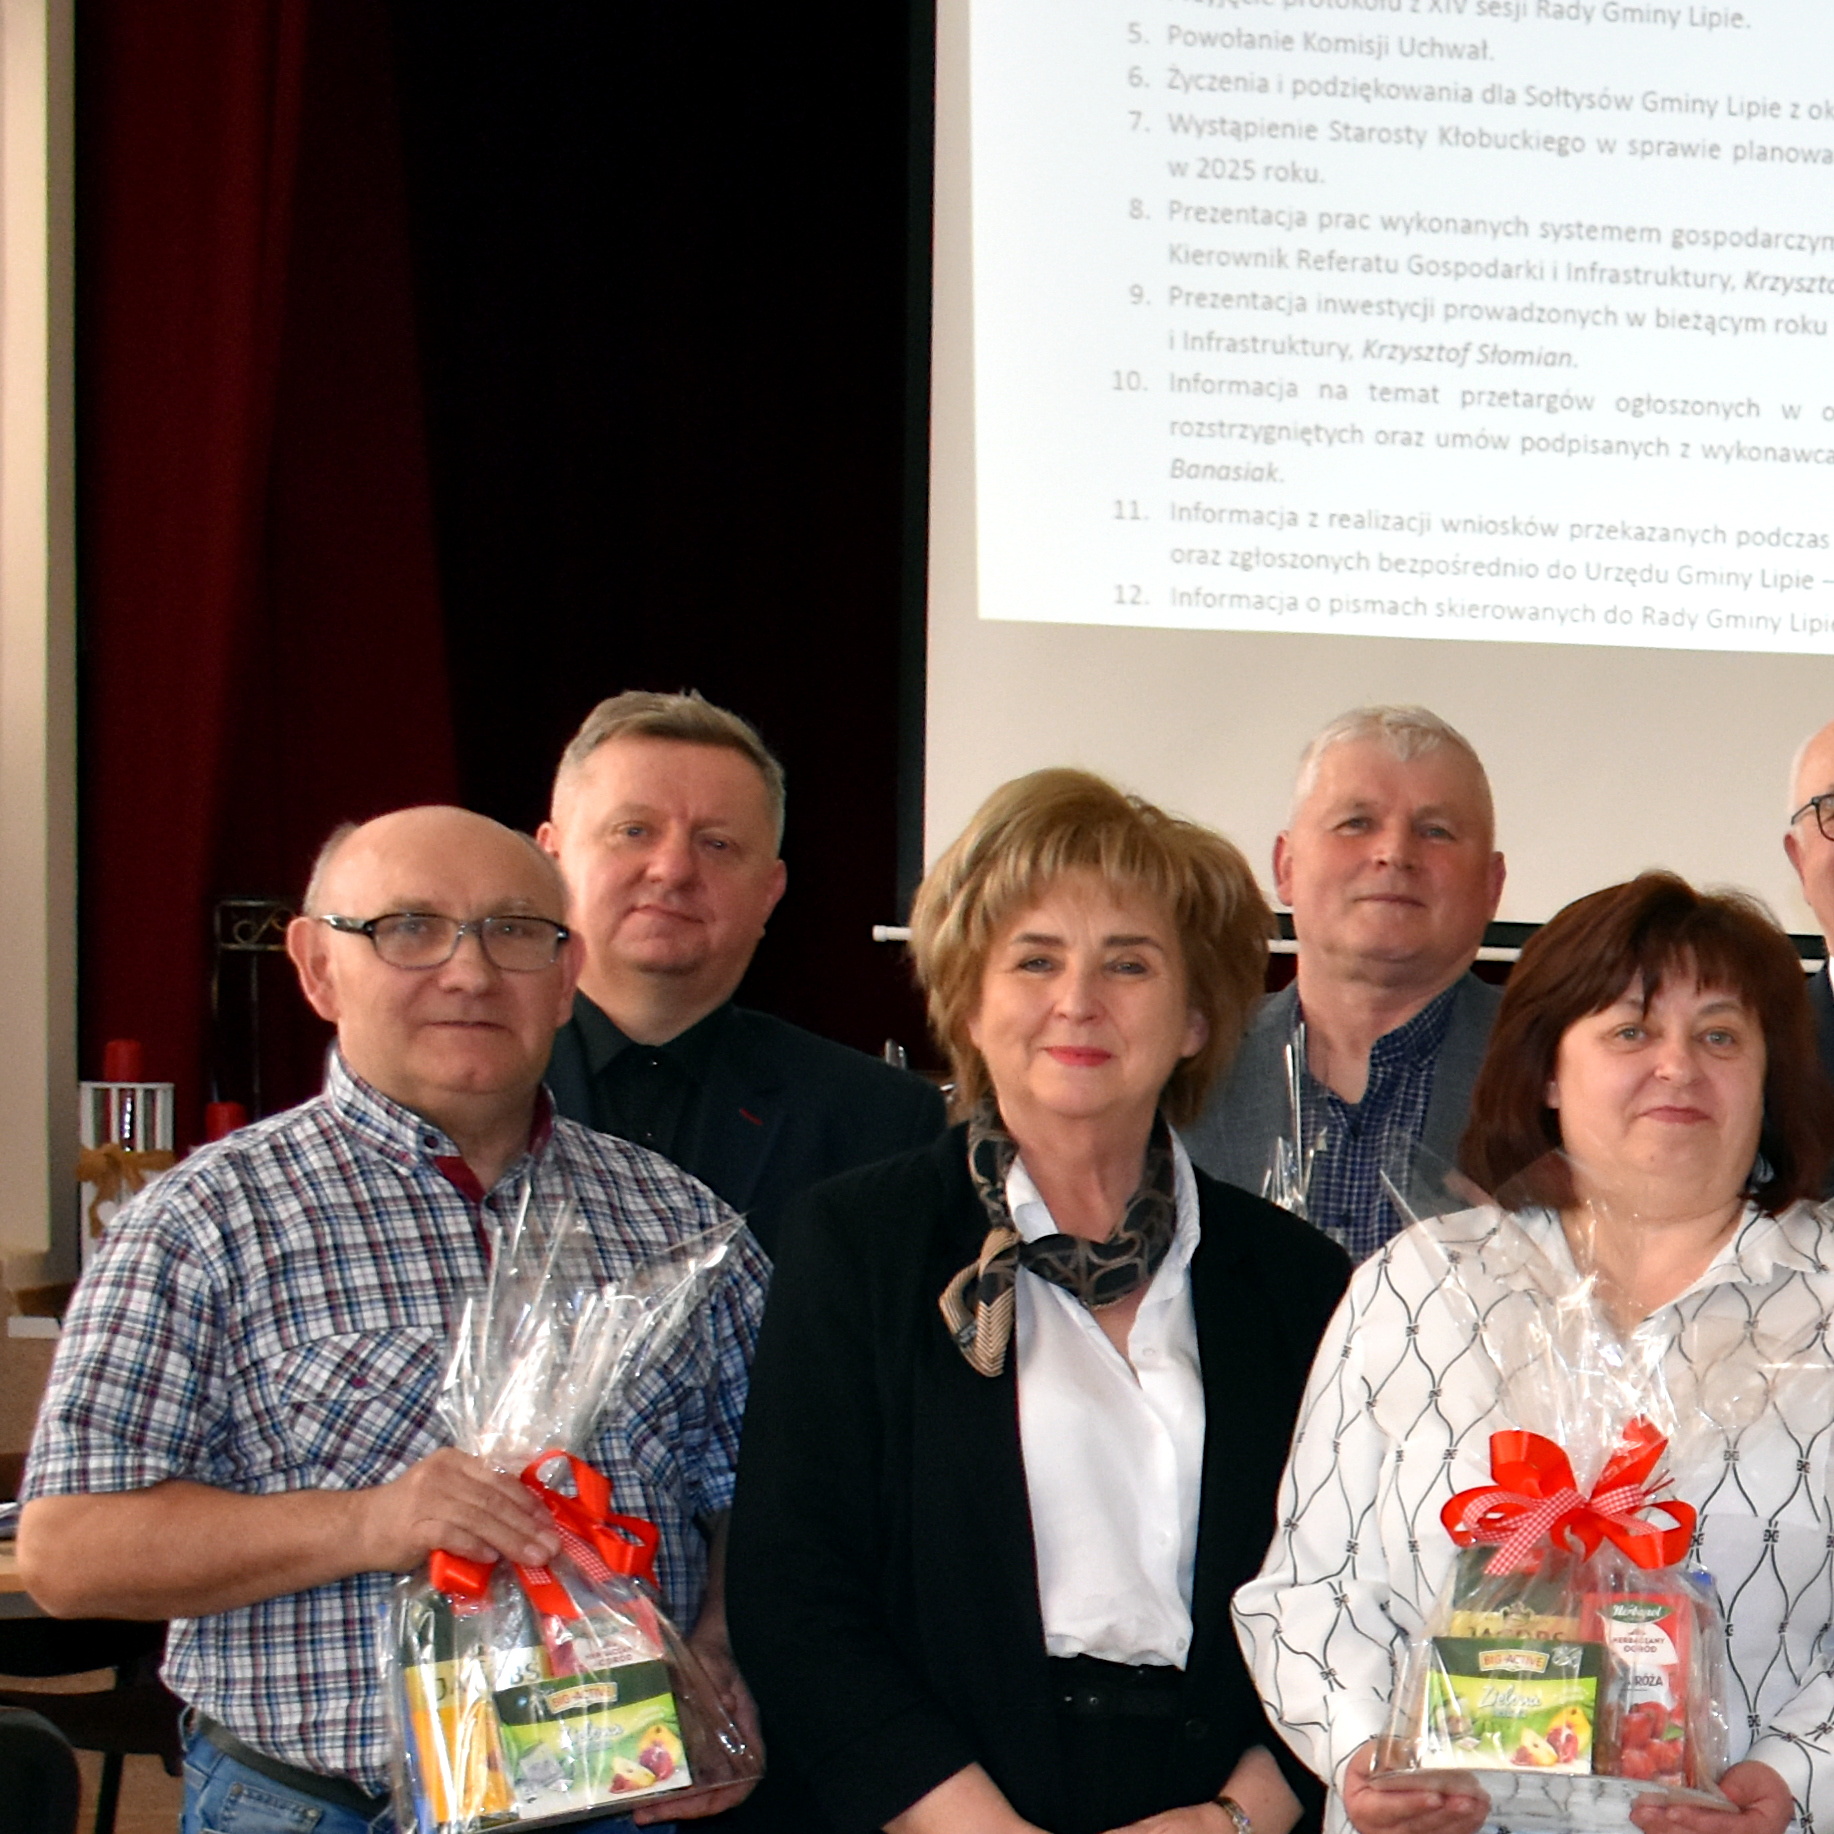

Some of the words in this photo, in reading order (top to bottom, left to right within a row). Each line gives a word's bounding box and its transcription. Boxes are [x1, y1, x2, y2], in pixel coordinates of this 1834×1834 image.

[1126, 20, 1150, 46] 5.
[1166, 23, 1296, 53] Powołanie
[1301, 30, 1390, 62] Komisji
[1534, 0, 1598, 27] Rady
[1601, 0, 1683, 31] Gminy
[1687, 4, 1752, 33] Lipie.
[1126, 64, 1151, 89] 6.
[1165, 63, 1271, 95] Życzenia
[1480, 82, 1518, 107] dla
[1523, 83, 1635, 113] Sołtysów
[1640, 89, 1720, 120] Gminy
[1726, 94, 1783, 122] Lipie
[1788, 101, 1801, 121] z
[1127, 109, 1151, 133] 7.
[1166, 112, 1319, 143] Wystąpienie
[1328, 118, 1429, 150] Starosty
[1437, 124, 1587, 159] Kłobuckiego
[1595, 137, 1618, 156] w
[1627, 137, 1723, 161] sprawie
[1166, 160, 1190, 179] w
[1195, 155, 1257, 182] 2025
[1262, 159, 1326, 185] roku.
[1127, 196, 1151, 221] 8.
[1167, 198, 1308, 233] Prezentacja
[1317, 211, 1371, 234] prac
[1379, 210, 1530, 241] wykonanych
[1538, 220, 1663, 245] systemem
[1167, 242, 1290, 270] Kierownik
[1295, 247, 1400, 275] Referatu
[1406, 252, 1545, 282] Gospodarki
[1565, 260, 1737, 295] Infrastruktury,
[1127, 282, 1151, 306] 9.
[1167, 284, 1308, 318] Prezentacja
[1316, 296, 1436, 324] inwestycji
[1442, 301, 1619, 330] prowadzonych
[1624, 311, 1647, 329] w
[1654, 306, 1768, 337] bieżącym
[1773, 313, 1829, 337] roku
[1182, 329, 1354, 363] Infrastruktury,
[1360, 338, 1474, 369] Krzysztof
[1112, 368, 1149, 392] 10.
[1168, 371, 1299, 403] Informacja
[1318, 382, 1349, 402] na
[1367, 382, 1441, 406] temat
[1459, 388, 1596, 416] przetargów
[1614, 392, 1762, 422] ogłoszonych
[1780, 403, 1803, 421] w
[1373, 428, 1426, 449] oraz
[1434, 426, 1511, 452] umów
[1519, 432, 1671, 461] podpisanych
[1679, 441, 1692, 460] z
[1168, 456, 1285, 484] Banasiak.
[1113, 498, 1150, 522] 11.
[1169, 500, 1300, 532] Informacja
[1307, 510, 1320, 530] z
[1327, 508, 1432, 538] realizacji
[1439, 514, 1560, 538] wniosków
[1568, 519, 1728, 548] przekazanych
[1735, 526, 1831, 551] podczas
[1169, 547, 1222, 568] oraz
[1227, 545, 1372, 575] zgłoszonych
[1545, 559, 1578, 582] do
[1584, 561, 1670, 589] Urzędu
[1676, 563, 1754, 592] Gminy
[1759, 567, 1816, 594] Lipie
[1113, 583, 1150, 607] 12.
[1170, 585, 1300, 616] Informacja
[1305, 595, 1322, 613] o
[1328, 595, 1428, 617] pismach
[1434, 597, 1597, 626] skierowanych
[1602, 604, 1634, 626] do
[1641, 604, 1699, 631] Rady
[1705, 607, 1782, 635] Gminy
